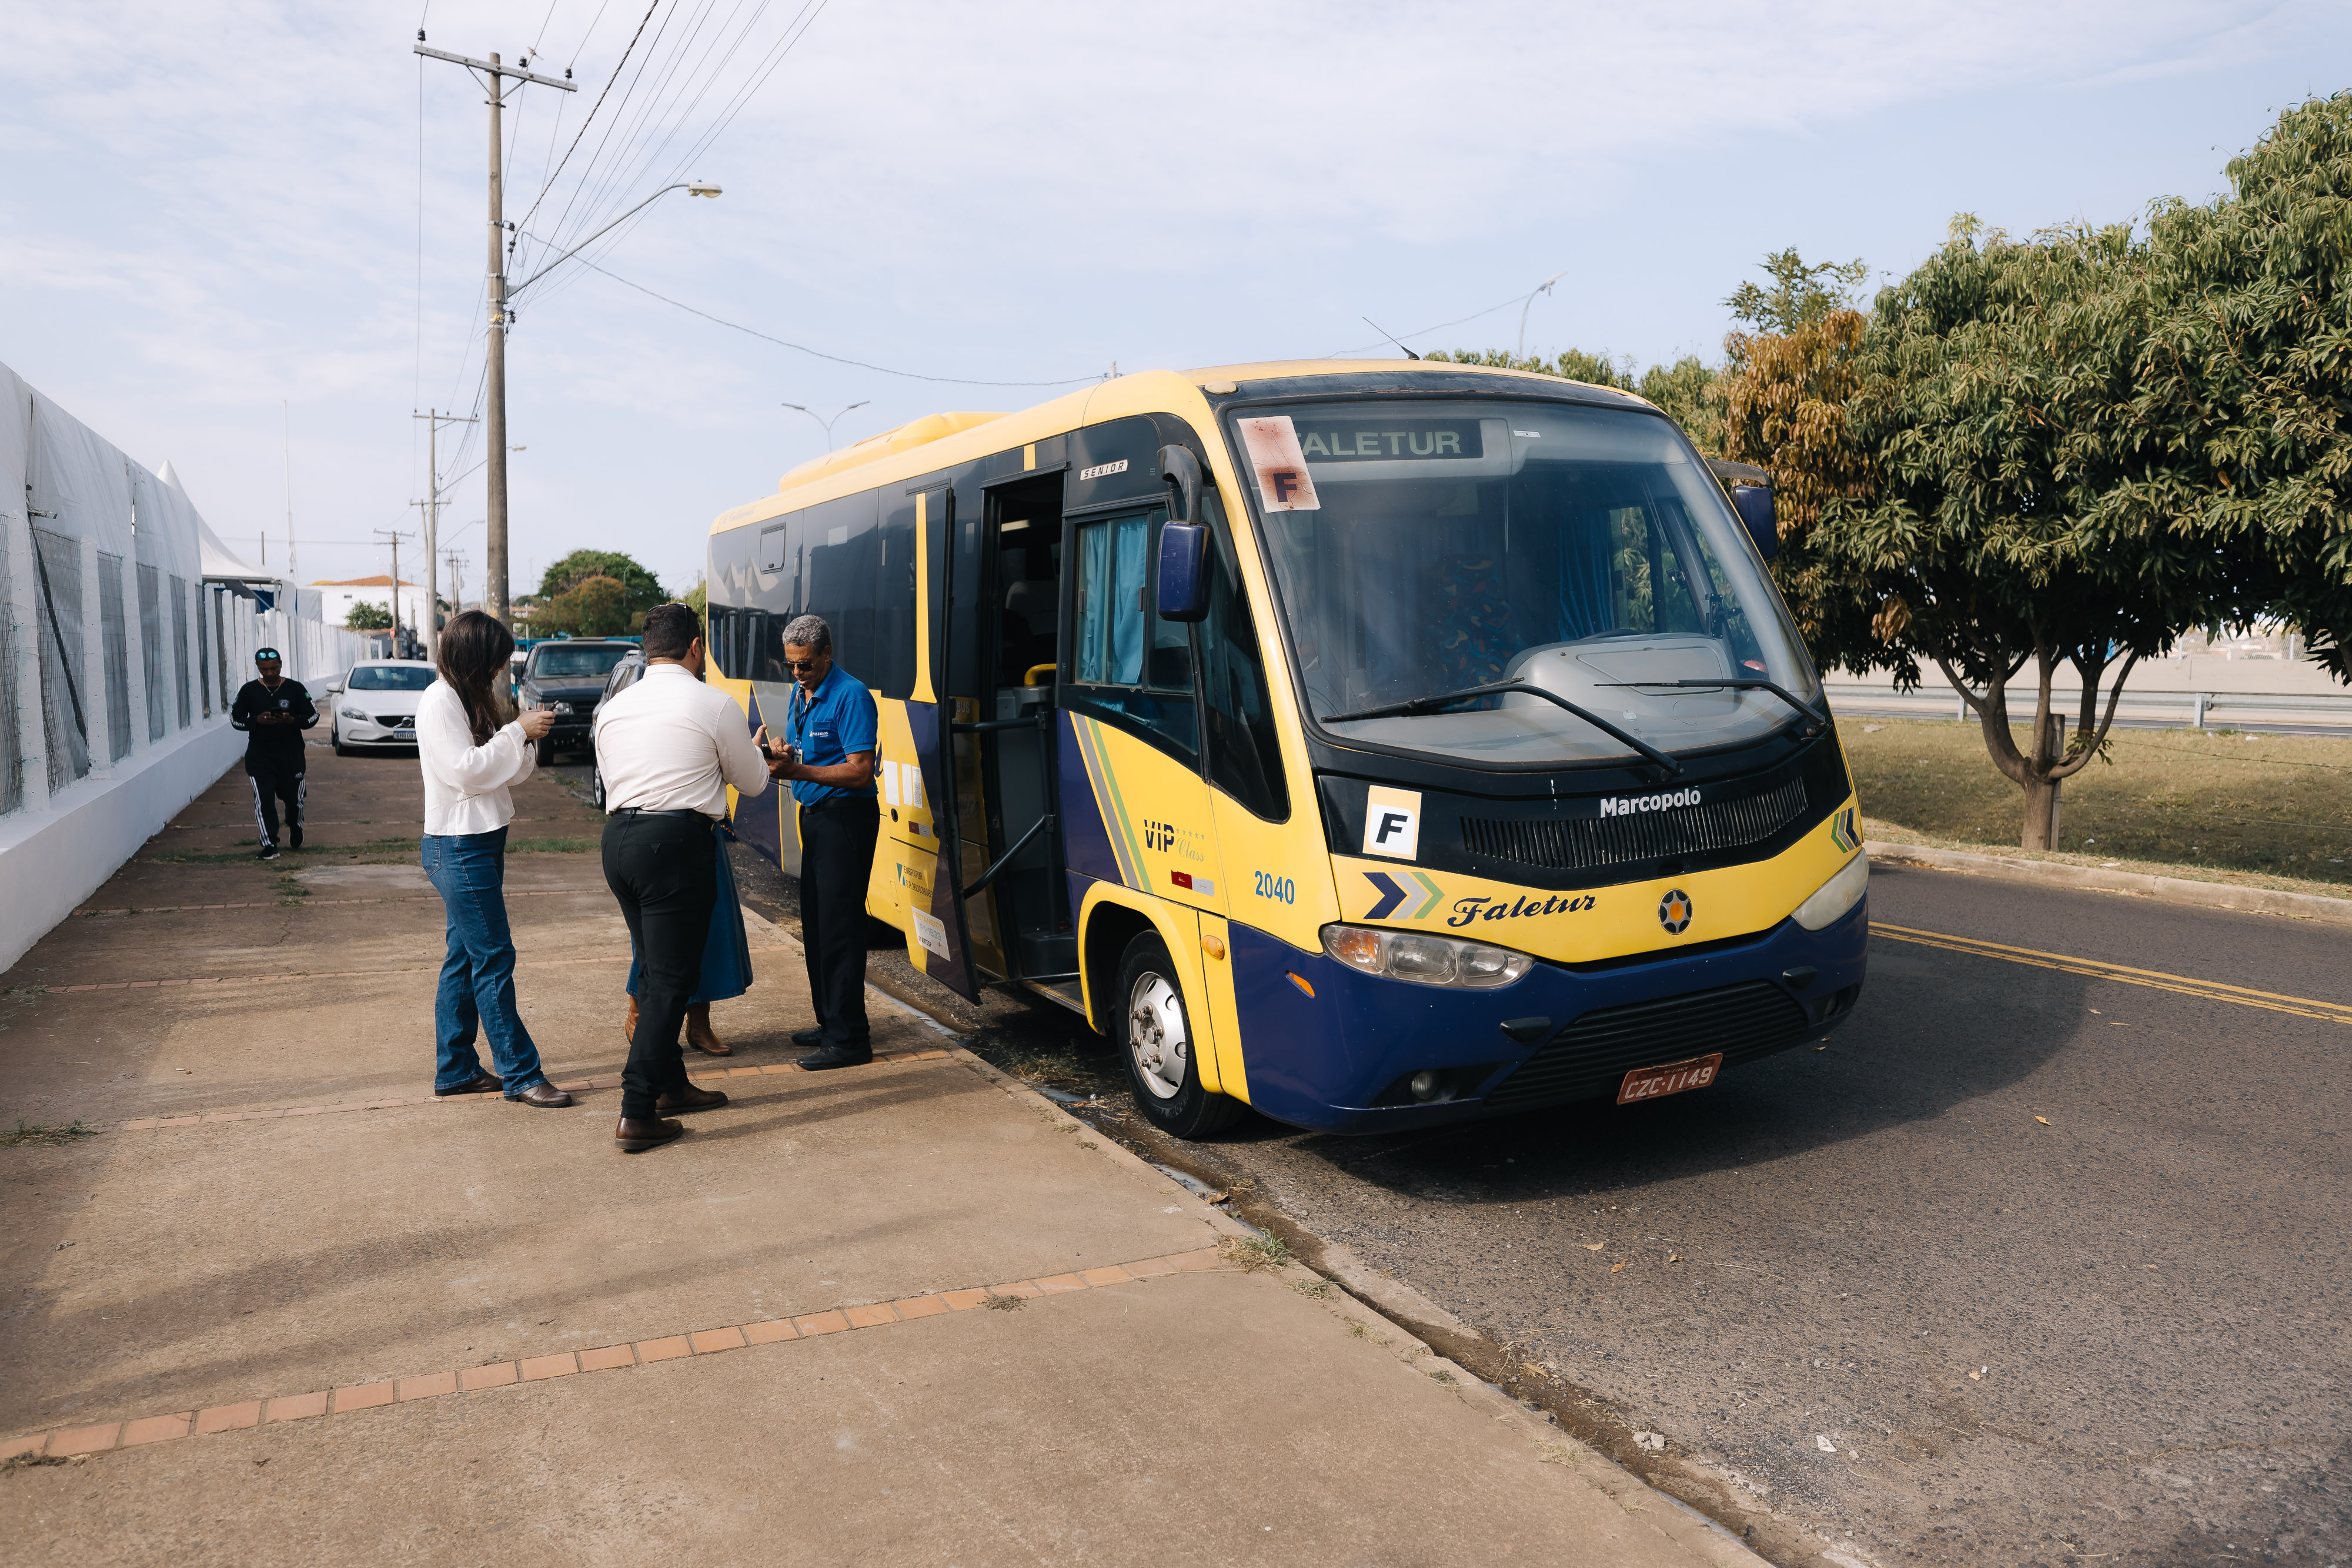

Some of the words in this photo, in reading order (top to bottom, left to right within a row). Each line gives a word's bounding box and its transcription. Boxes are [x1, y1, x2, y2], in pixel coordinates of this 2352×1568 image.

[1297, 431, 1462, 456] ALETUR
[1084, 462, 1124, 478] SENIOR
[1272, 472, 1298, 503] F
[956, 700, 970, 714] BUS
[1600, 788, 1701, 818] Marcopolo
[1144, 819, 1174, 852] VIP
[1177, 838, 1205, 862] Class
[1376, 813, 1408, 844] F
[903, 865, 923, 881] EMBRATUR
[1255, 870, 1295, 904] 2040
[913, 911, 944, 932] FRETAMENTO
[1447, 895, 1597, 928] Faletur
